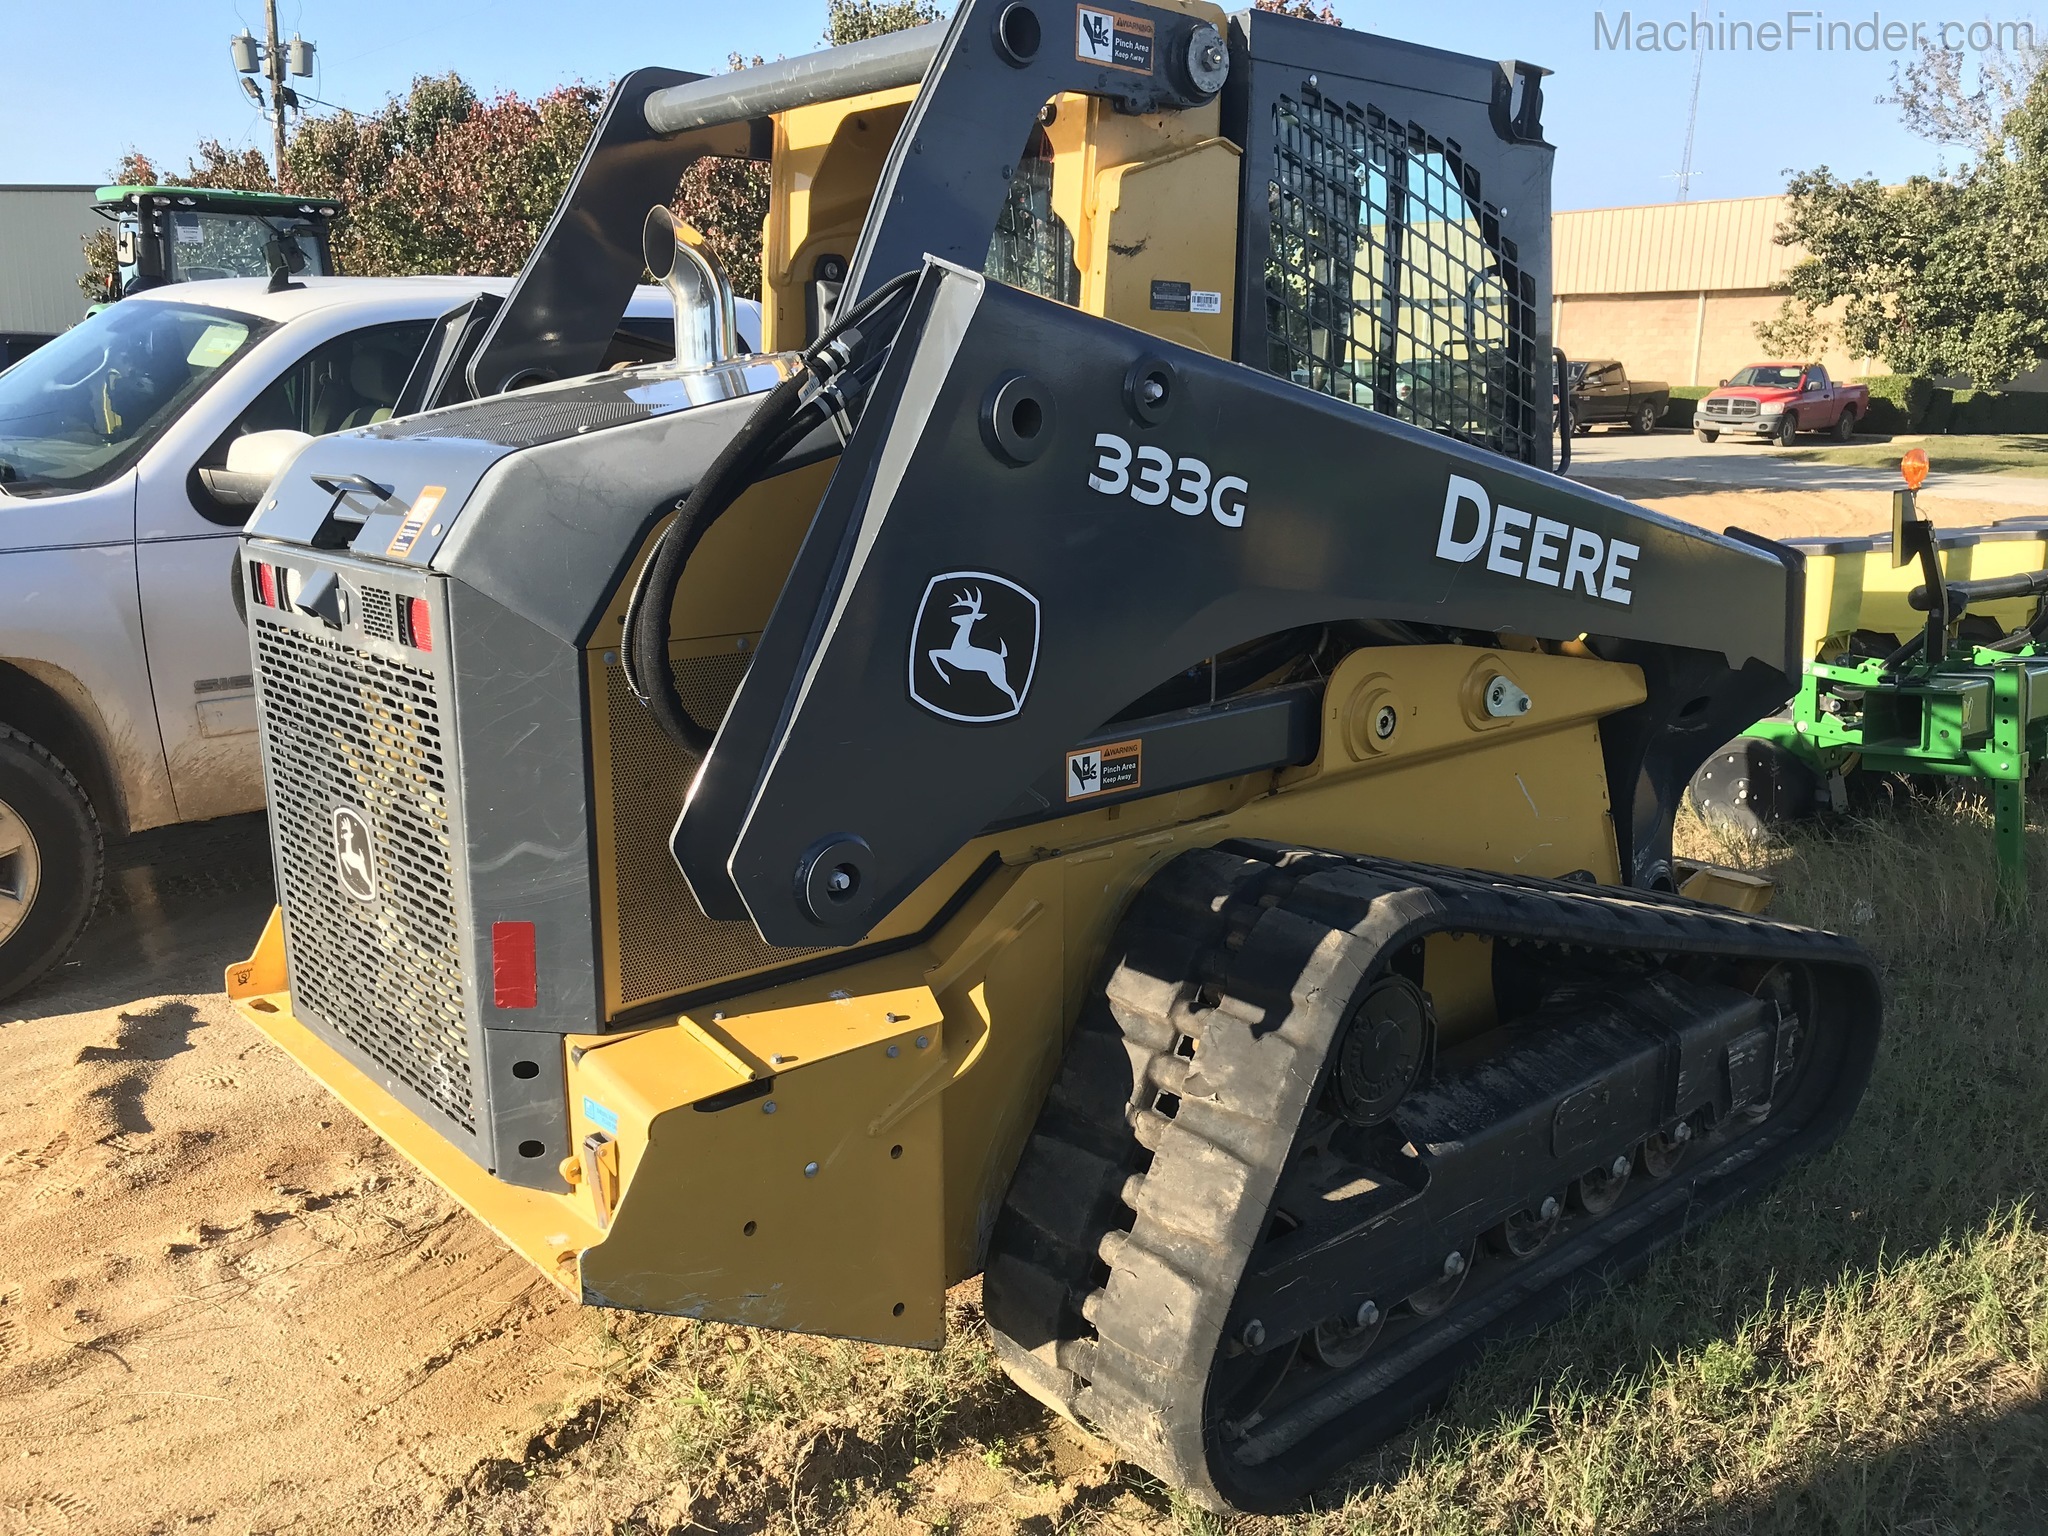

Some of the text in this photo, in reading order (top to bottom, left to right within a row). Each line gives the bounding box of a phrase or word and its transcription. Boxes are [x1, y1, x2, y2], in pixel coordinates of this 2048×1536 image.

[1122, 19, 1153, 33] WARNING
[1115, 37, 1149, 53] Pinch Area
[1114, 49, 1145, 63] Keep Away
[1088, 433, 1248, 527] 333G
[1436, 474, 1640, 605] DEERE
[1110, 744, 1138, 756] WARNING
[1103, 763, 1136, 774] Pinch Area
[1102, 773, 1132, 784] Keep Away
